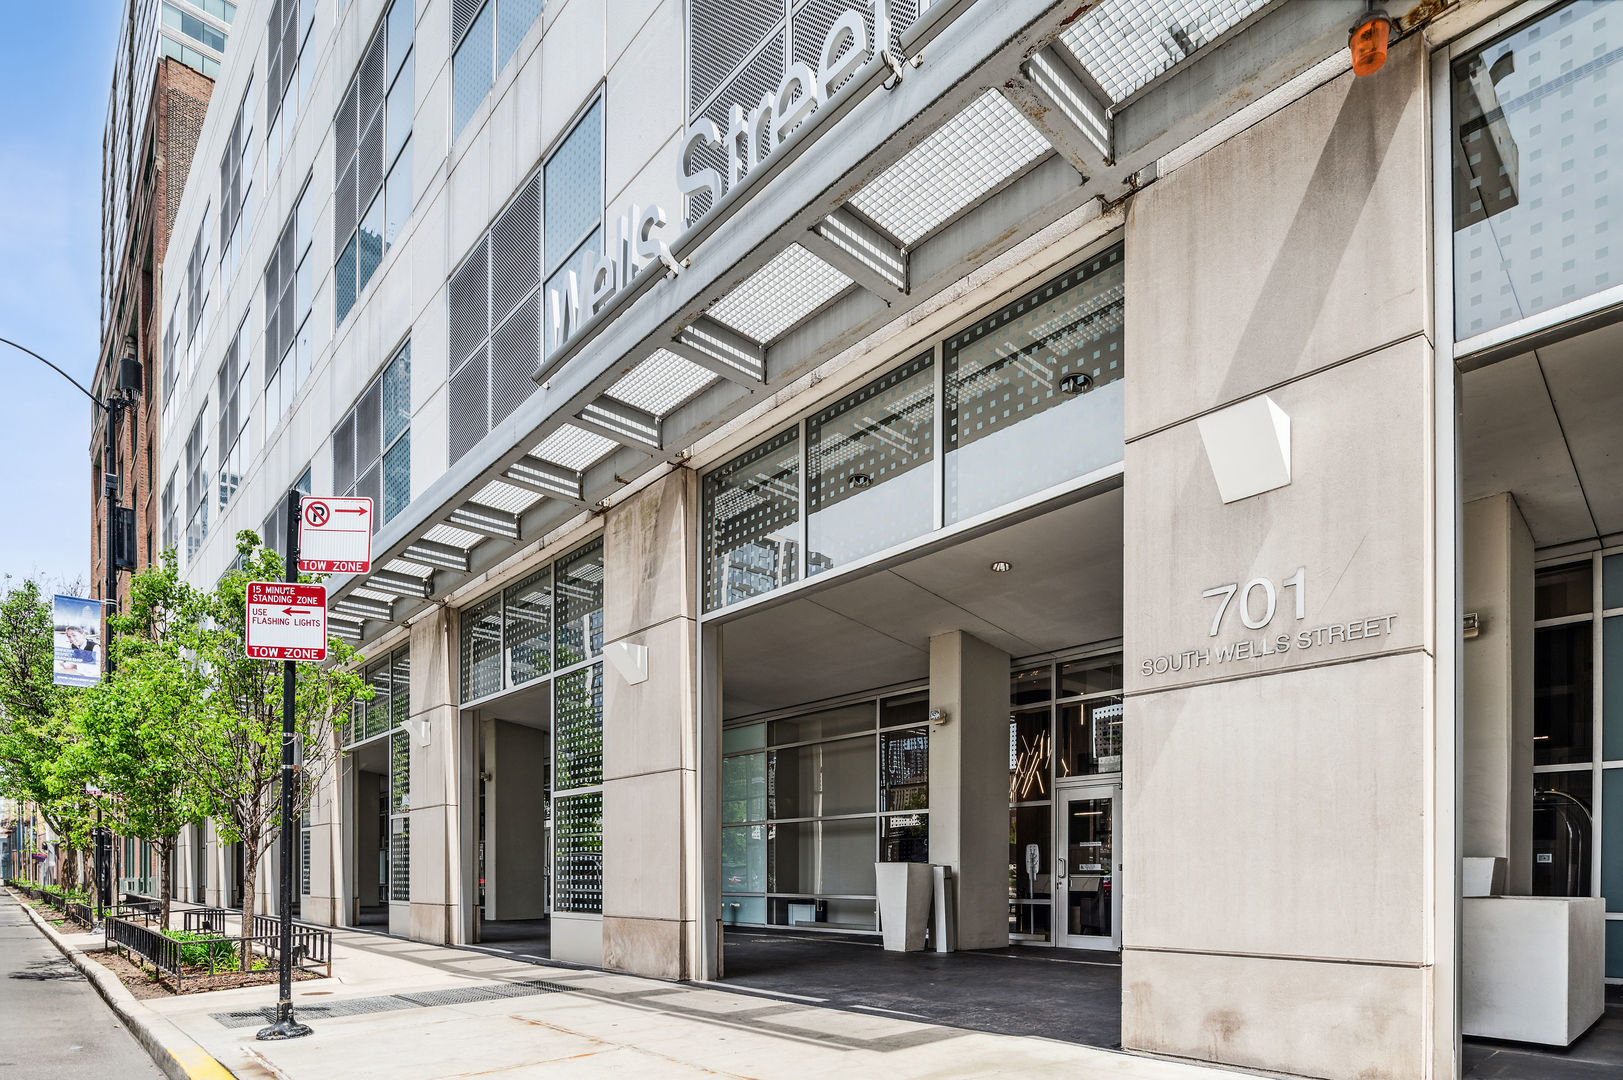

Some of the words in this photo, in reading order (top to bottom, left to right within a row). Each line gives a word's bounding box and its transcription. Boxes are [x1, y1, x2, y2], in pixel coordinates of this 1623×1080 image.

[551, 203, 668, 352] Wells
[302, 560, 327, 571] TOW
[332, 561, 364, 572] ZONE
[252, 585, 262, 594] 15
[265, 586, 296, 595] MINUTE
[252, 594, 293, 604] STANDING
[296, 596, 318, 605] ZONE
[1202, 566, 1306, 637] 701
[252, 608, 268, 616] USE
[252, 616, 290, 626] FLASHING
[294, 618, 321, 627] LIGHTS
[1141, 648, 1210, 677] SOUTH
[1215, 633, 1291, 663] WELLS
[1296, 613, 1398, 650] STREET
[252, 646, 279, 658] TOW
[285, 648, 319, 659] ZONE
